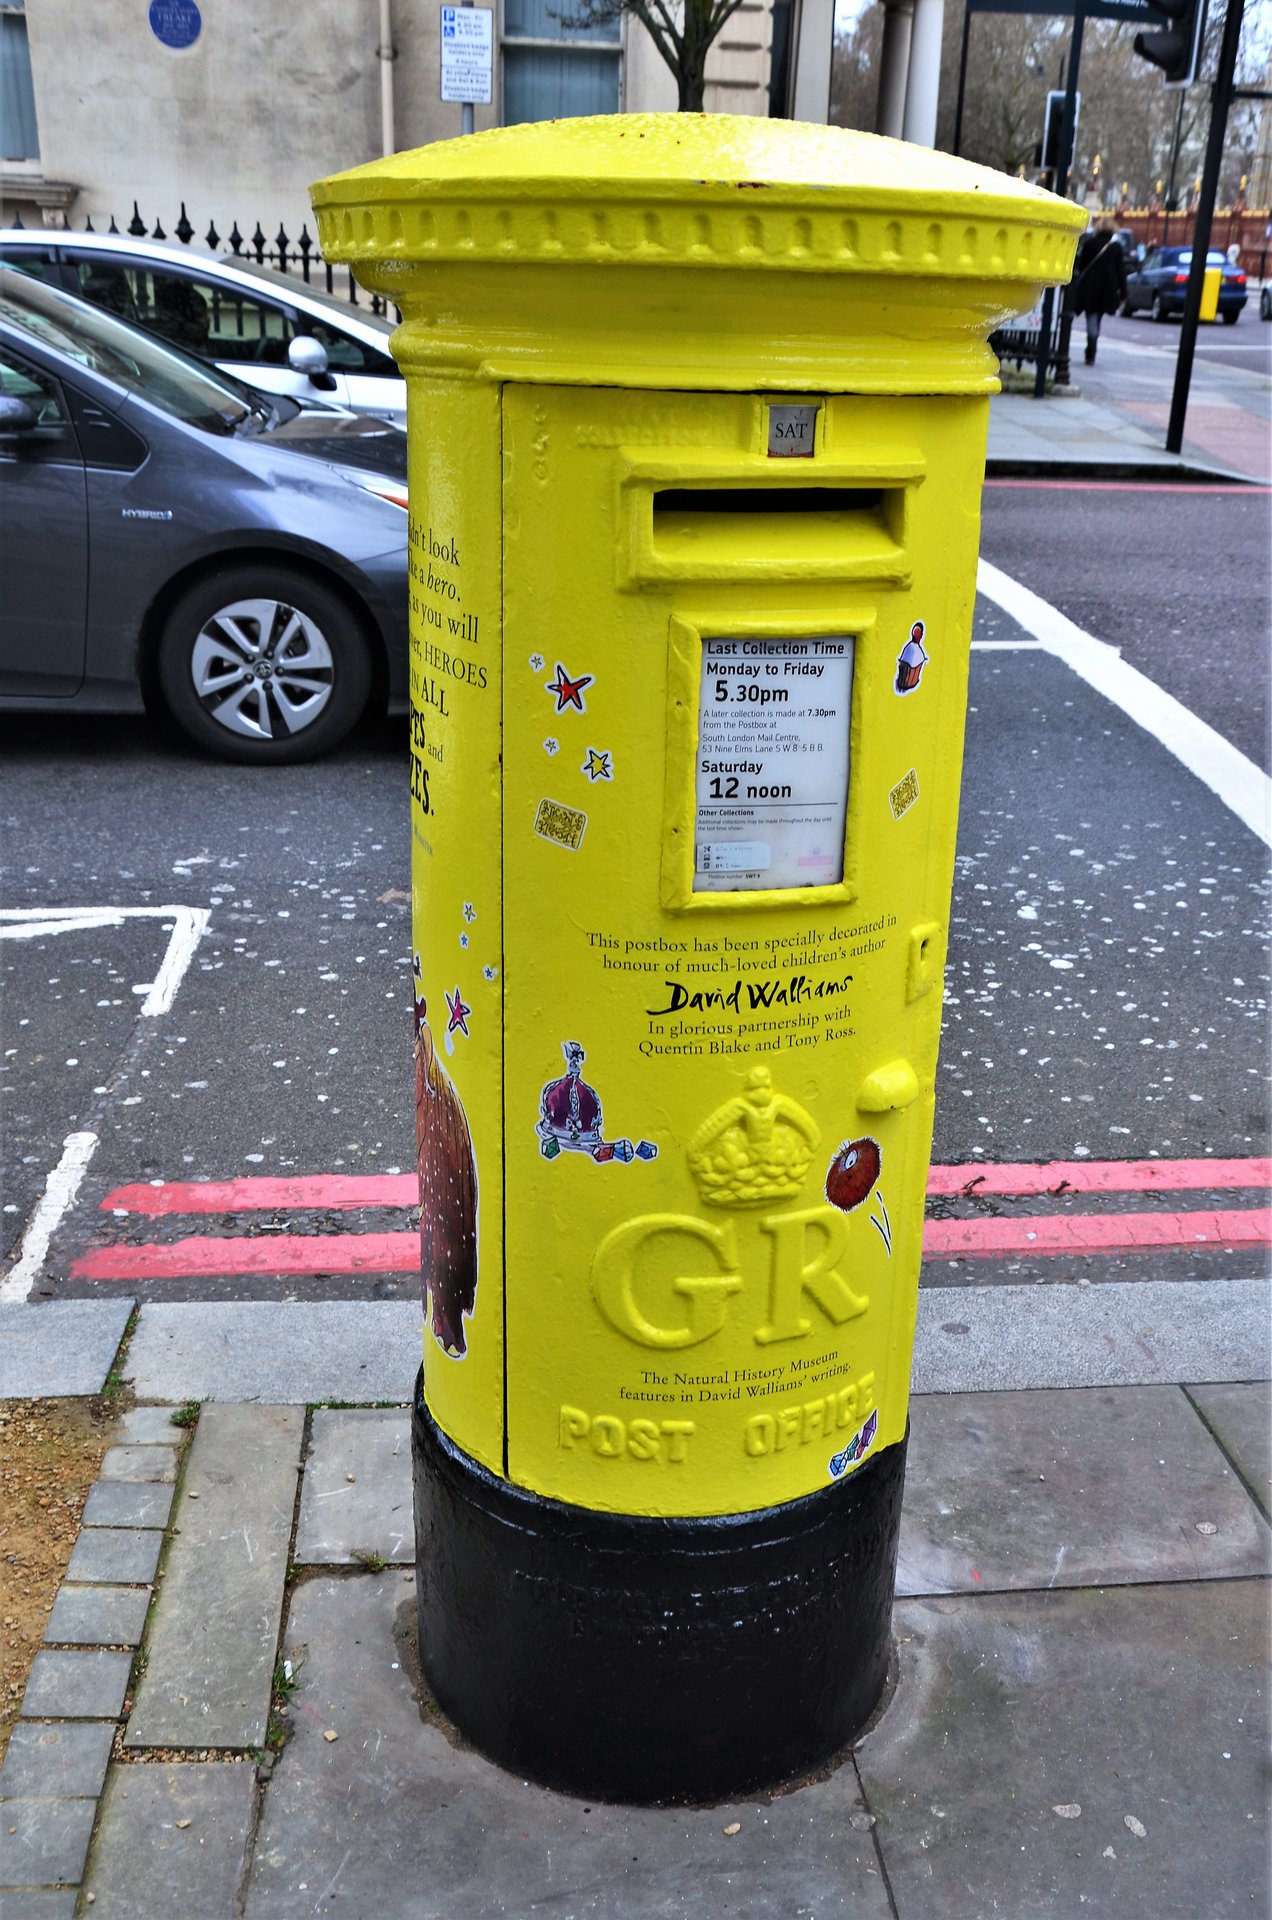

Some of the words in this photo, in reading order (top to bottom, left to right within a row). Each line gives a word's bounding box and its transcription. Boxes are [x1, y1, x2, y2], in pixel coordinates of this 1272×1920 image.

[775, 422, 808, 439] SAT
[122, 508, 164, 520] HYBRID
[428, 527, 460, 566] look
[420, 568, 425, 585] a
[427, 562, 461, 602] hero.
[421, 602, 442, 628] you
[447, 613, 479, 644] will
[707, 642, 737, 655] Last
[742, 642, 808, 655] Collection
[812, 641, 844, 654] Time
[425, 641, 487, 689] HEROES
[706, 662, 760, 678] Monday
[765, 663, 779, 675] to
[784, 662, 824, 677] Friday
[421, 676, 449, 717] ALL
[715, 680, 789, 706] 5.30pm
[703, 710, 710, 718] A
[711, 710, 728, 718] later
[730, 709, 765, 718] collection
[767, 709, 773, 717] is
[775, 709, 796, 718] made
[798, 709, 806, 717] at
[807, 708, 836, 718] 7.30pm
[703, 721, 721, 729] from
[723, 721, 736, 729] the
[738, 721, 767, 729] Postbox
[769, 721, 777, 729] at
[428, 743, 443, 762] and
[702, 734, 725, 742] South
[727, 734, 756, 742] London
[757, 733, 773, 742] Mail
[702, 745, 713, 753] 53
[714, 745, 732, 753] Nine
[734, 745, 753, 753] Elms
[755, 744, 773, 753] Lane
[701, 760, 763, 775] Saturday
[709, 777, 739, 799] 12
[747, 785, 792, 798] noon
[586, 932, 620, 949] This
[625, 937, 688, 954] postbox
[694, 937, 718, 952] has
[724, 937, 759, 952] been
[764, 930, 824, 952] specially
[829, 915, 885, 942] decorated
[887, 913, 897, 927] in
[603, 954, 660, 972] honour
[665, 958, 682, 973] of
[686, 954, 777, 973] much-loved
[782, 947, 847, 968] children's
[850, 938, 886, 958] author
[646, 980, 743, 1016] David
[747, 975, 853, 1009] Walliams
[648, 1021, 664, 1034] In
[670, 1021, 733, 1038] glorious
[738, 1012, 820, 1036] partnership
[824, 1004, 852, 1022] with
[638, 1040, 703, 1057] Quentin
[709, 1040, 750, 1055] Blake
[755, 1035, 781, 1052] and
[785, 1034, 820, 1051] Tony
[825, 1026, 857, 1042] Ross.
[590, 1206, 870, 1350] GR
[619, 1387, 675, 1403] features
[681, 1390, 693, 1403] in
[699, 1387, 741, 1402] David
[746, 1374, 808, 1399] Walliams'
[810, 1362, 851, 1384] writing.
[640, 1371, 669, 1385] The
[674, 1370, 729, 1386] Natural
[733, 1366, 786, 1384] History
[789, 1350, 839, 1374] Museum
[557, 1404, 697, 1464] POST
[745, 1370, 876, 1457] OFFICE
